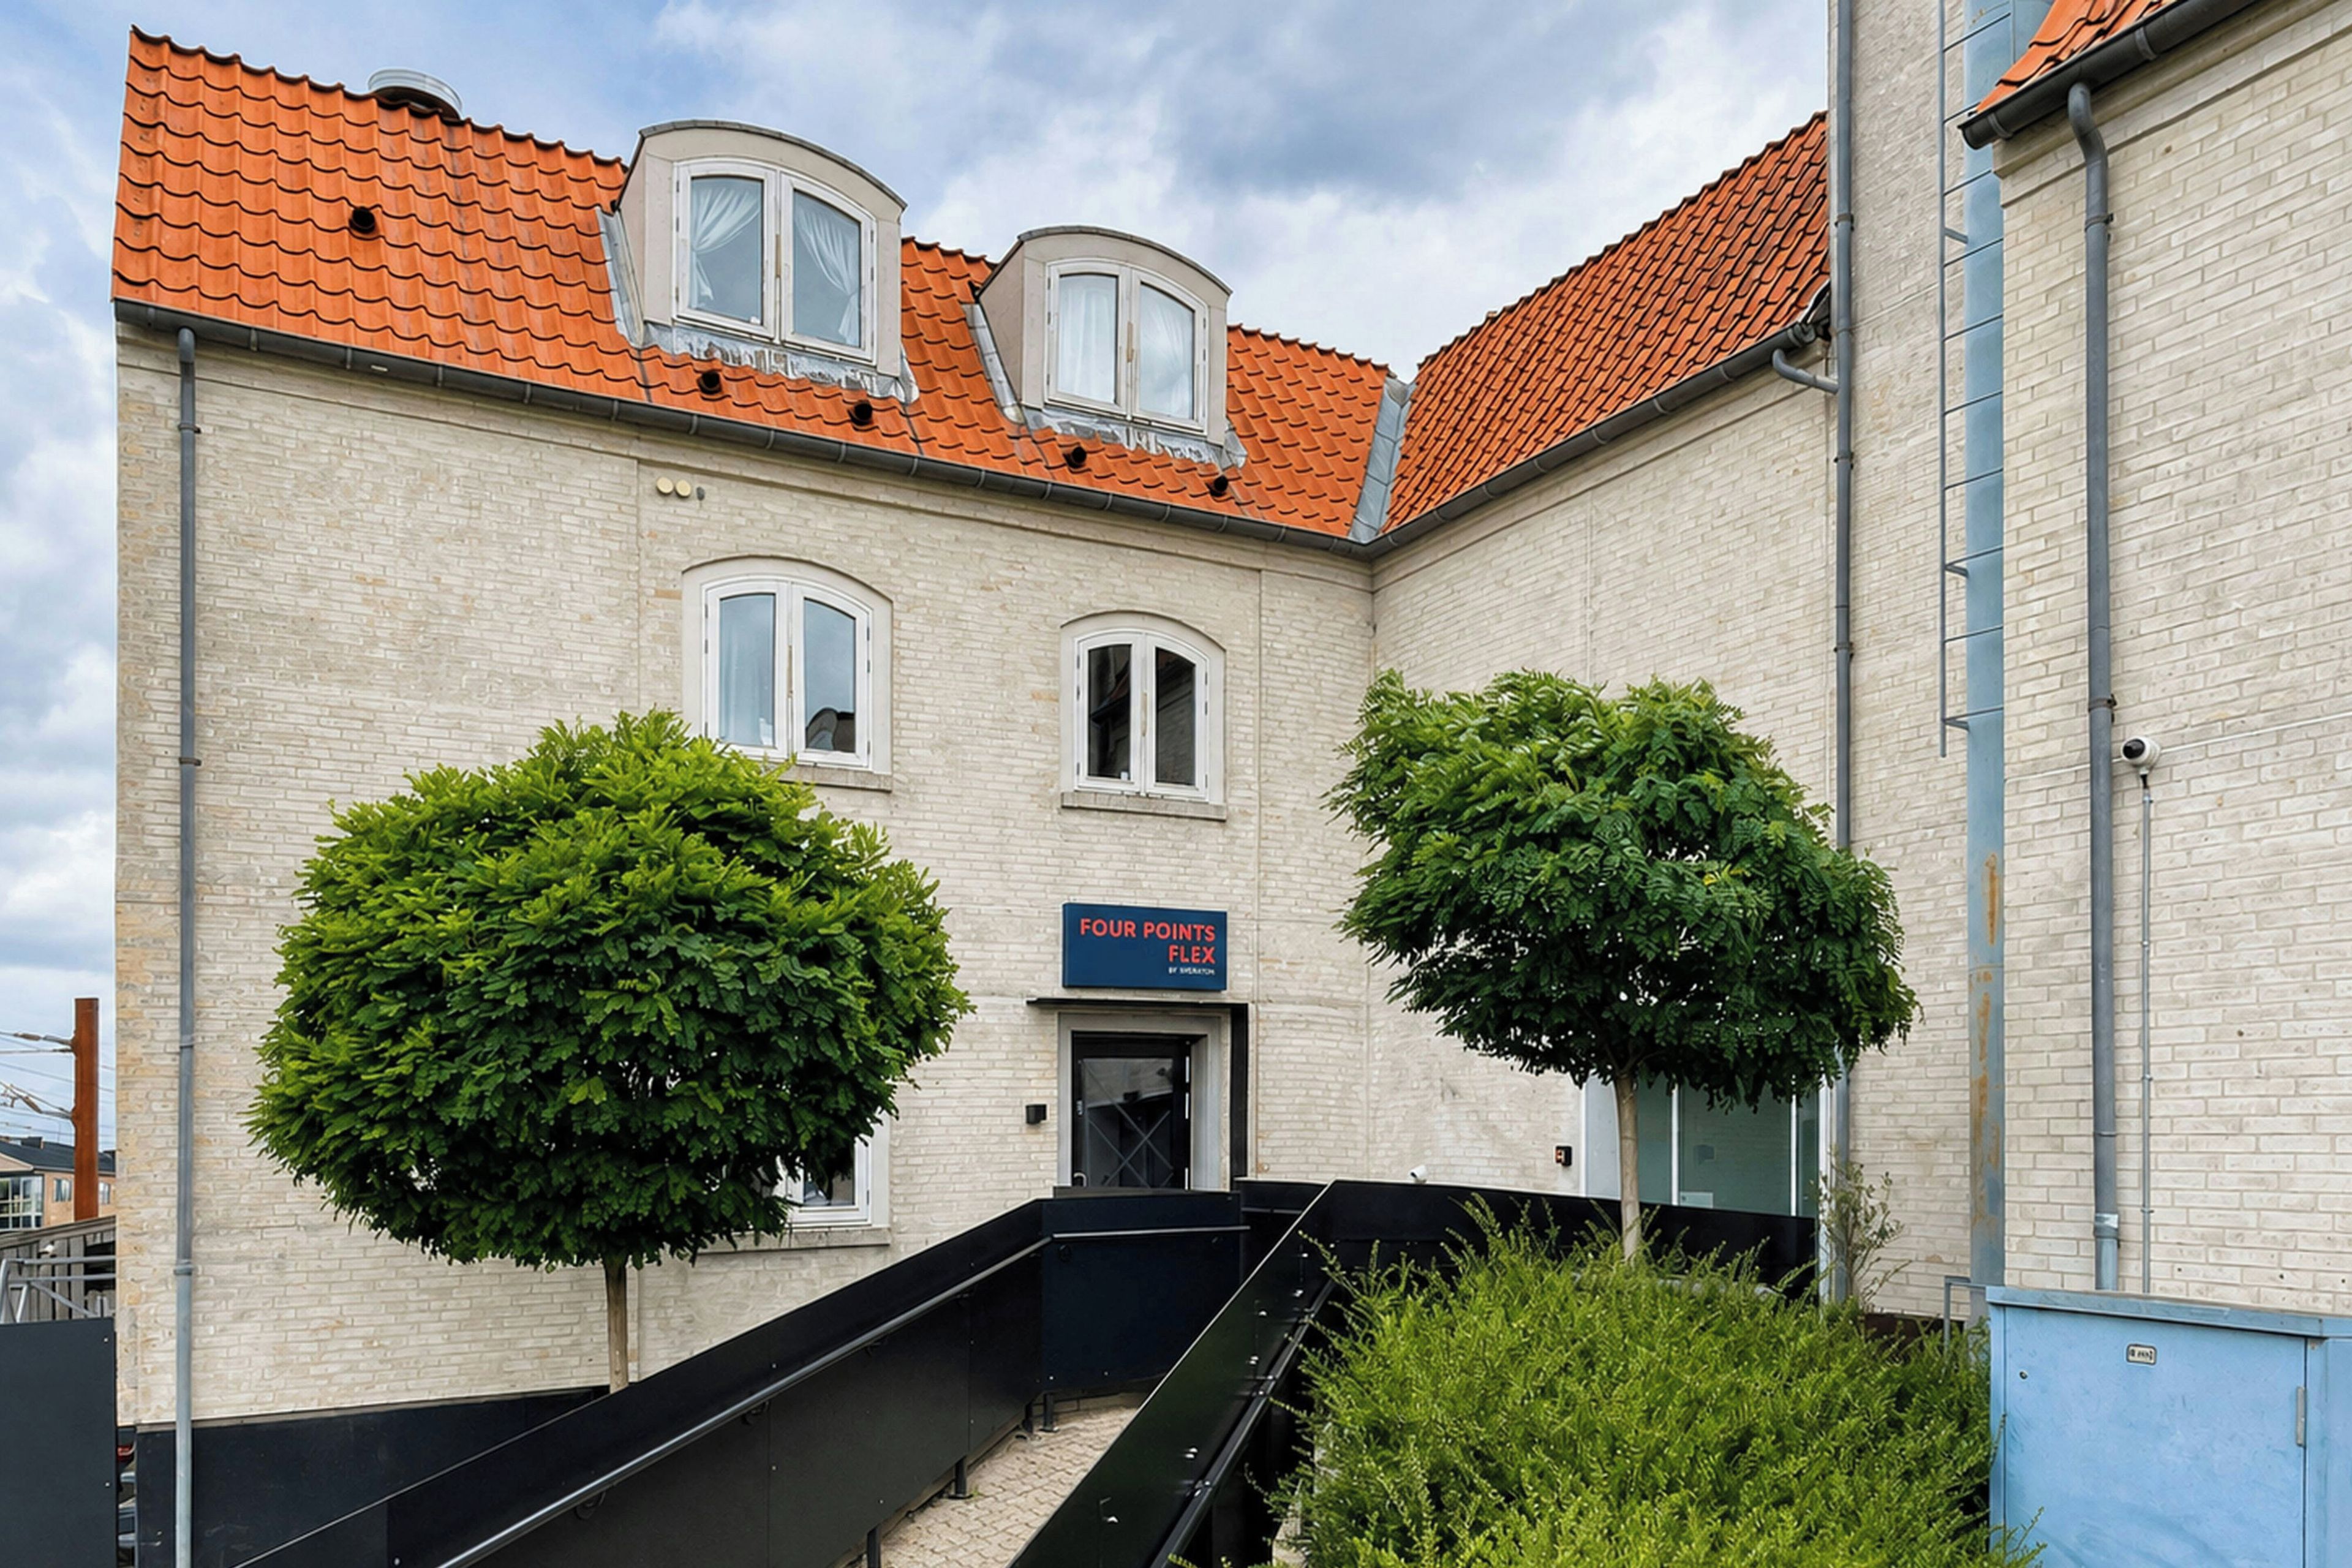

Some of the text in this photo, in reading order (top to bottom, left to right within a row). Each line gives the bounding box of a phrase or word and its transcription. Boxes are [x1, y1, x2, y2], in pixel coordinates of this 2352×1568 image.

[1080, 918, 1216, 942] FOUR POINTS
[1169, 944, 1216, 964] FLEX
